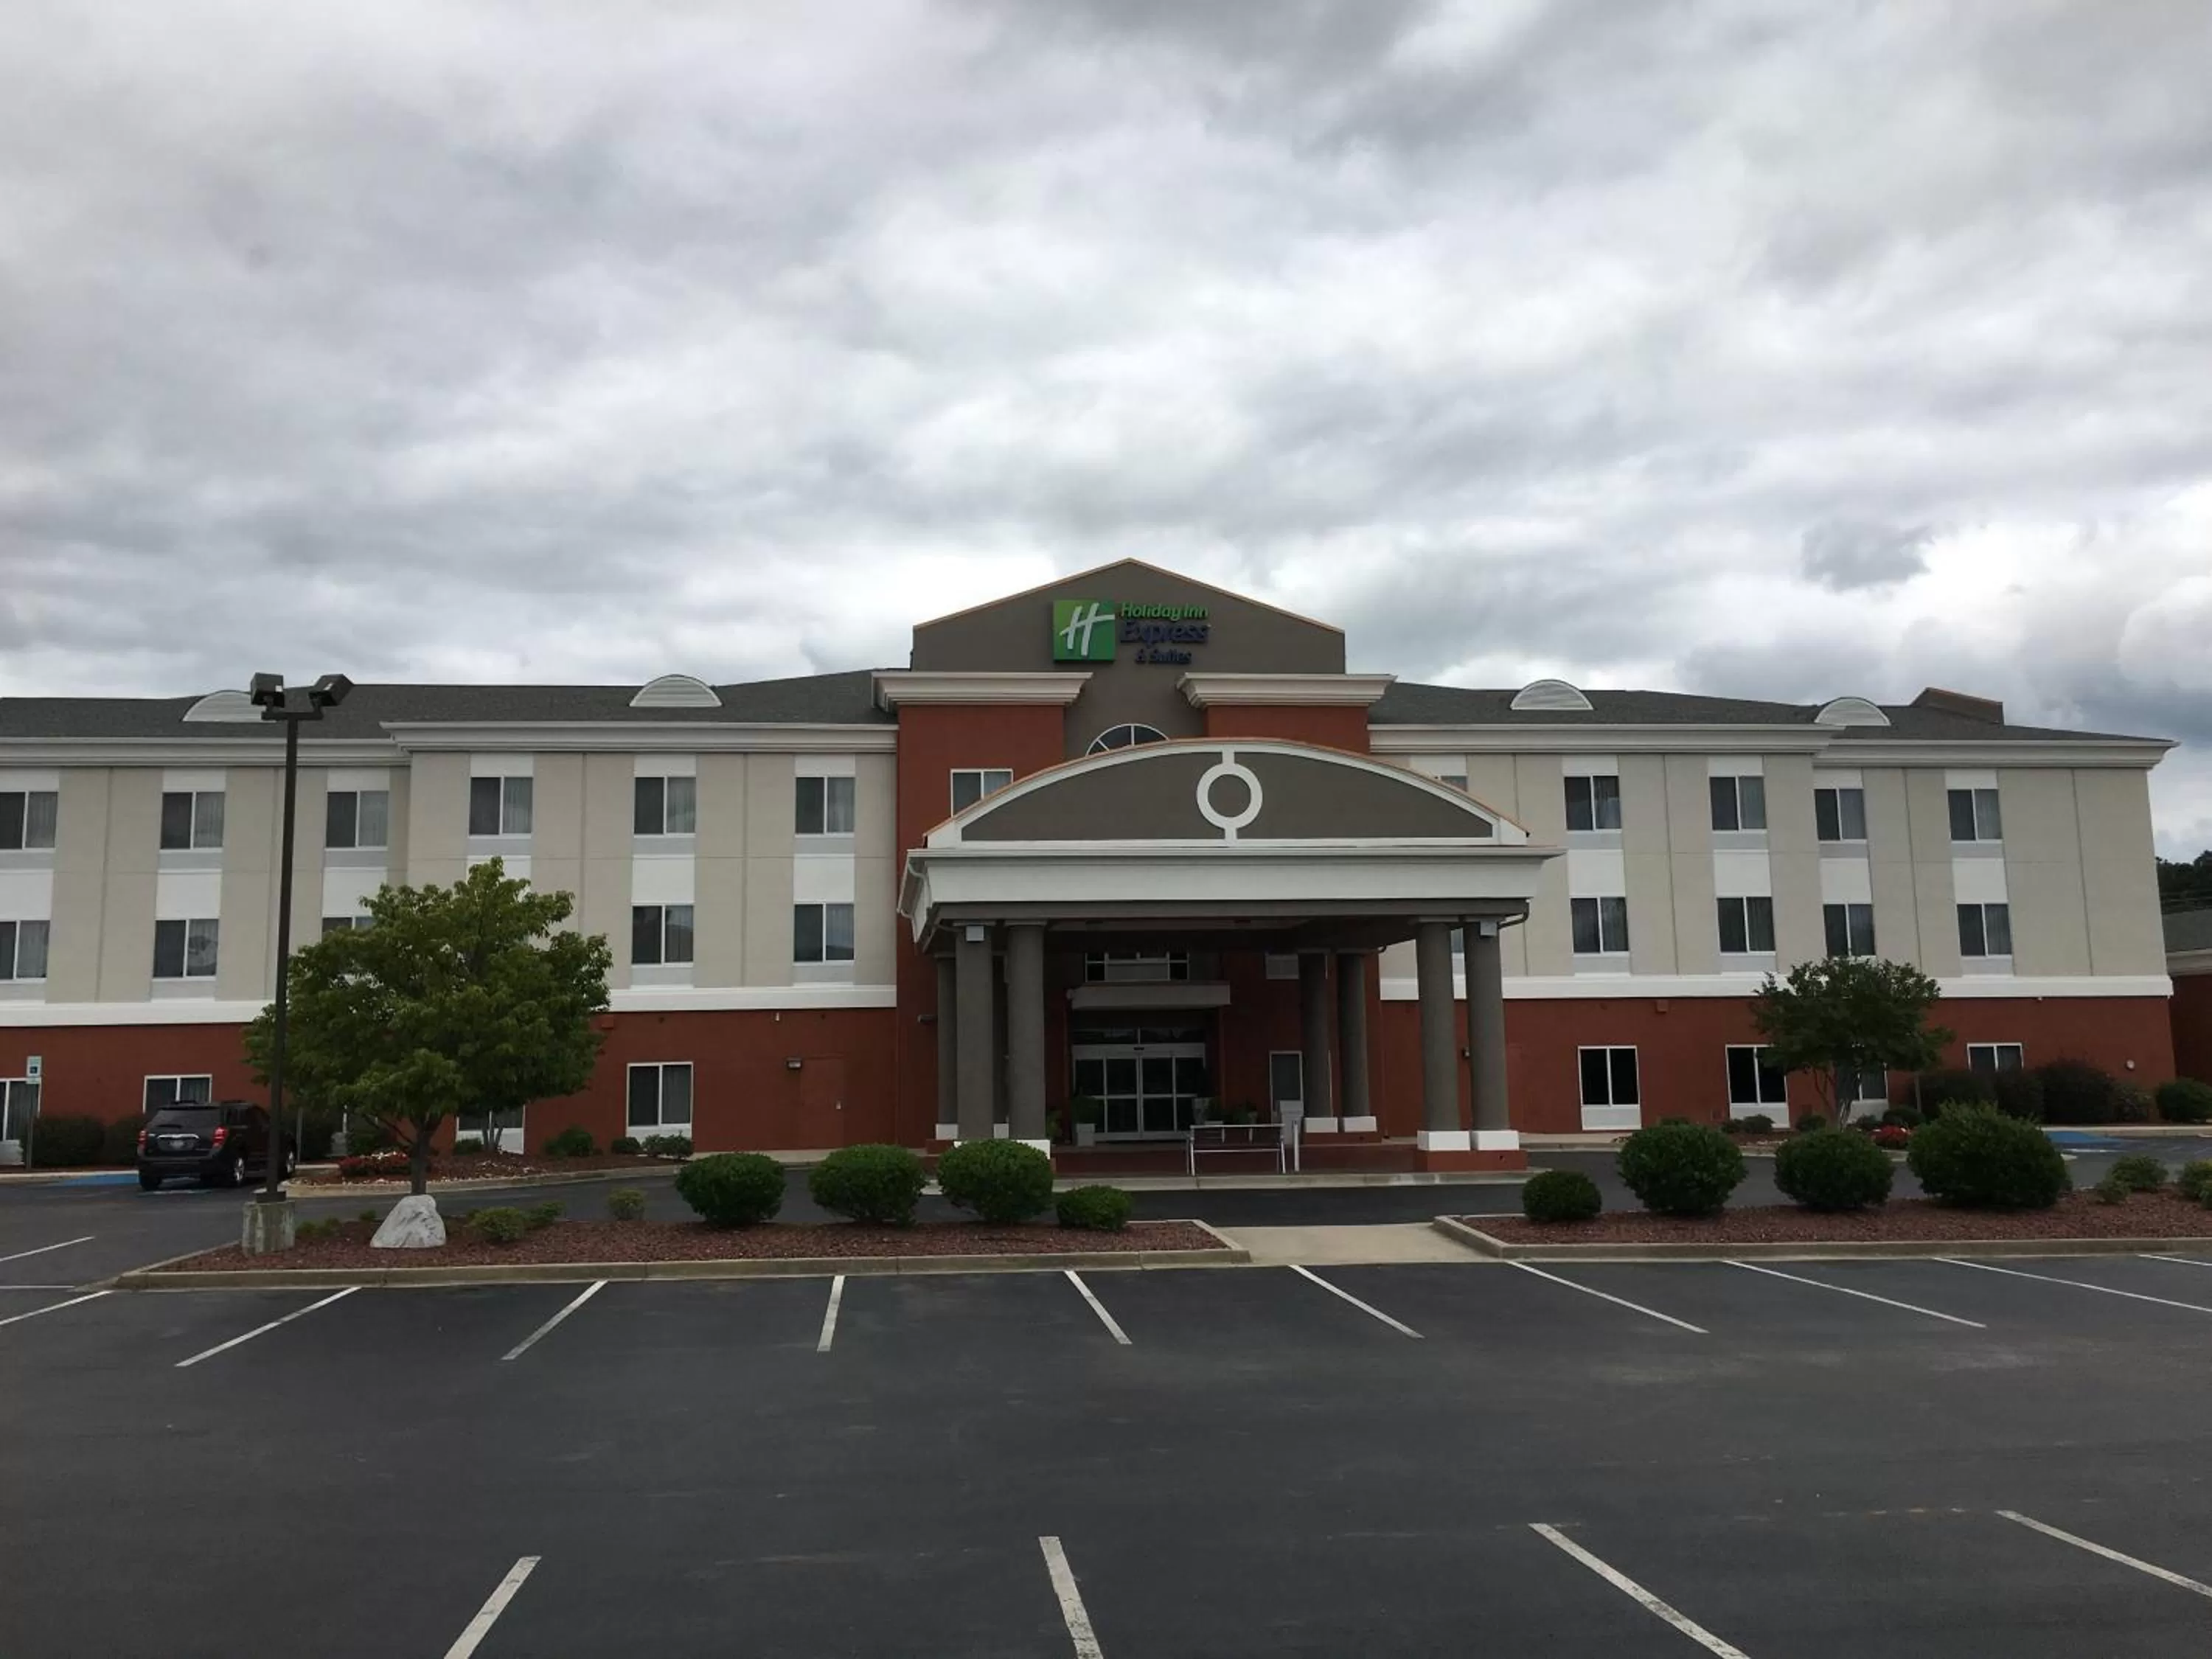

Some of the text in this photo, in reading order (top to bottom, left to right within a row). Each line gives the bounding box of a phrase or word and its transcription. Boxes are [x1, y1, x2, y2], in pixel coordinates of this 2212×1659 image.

[1120, 602, 1208, 621] Holiday Inn
[1120, 621, 1208, 645] Express
[1135, 647, 1192, 662] & Suites
